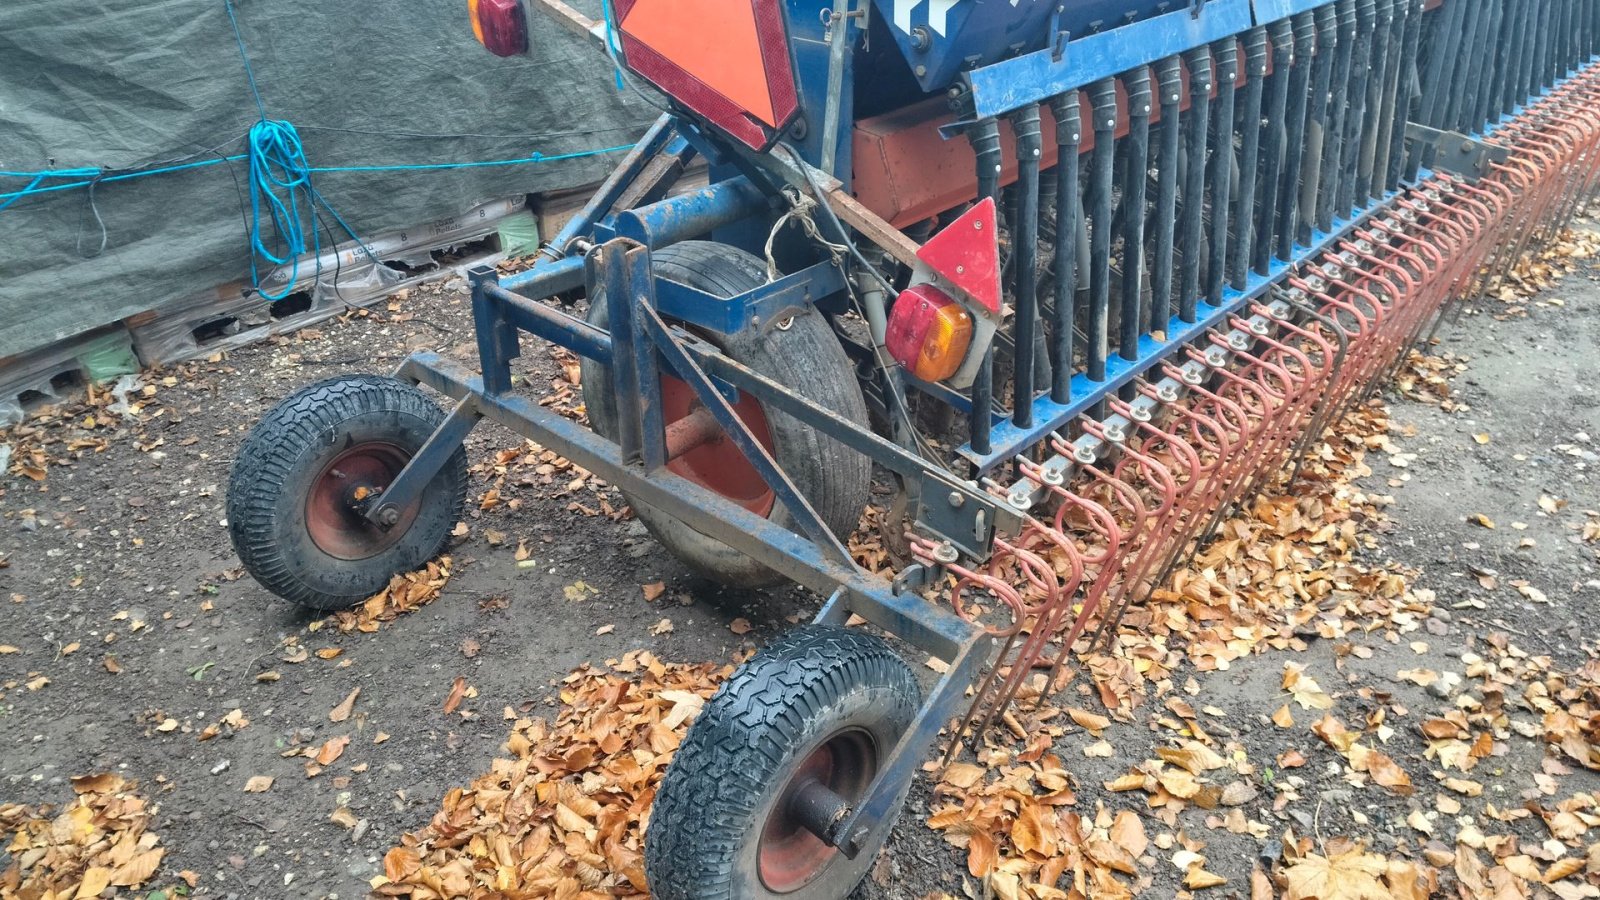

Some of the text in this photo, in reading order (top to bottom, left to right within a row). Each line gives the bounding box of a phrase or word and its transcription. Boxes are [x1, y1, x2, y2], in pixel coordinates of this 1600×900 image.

[479, 209, 486, 218] 8
[401, 232, 408, 242] 8
[354, 250, 383, 263] Pelets
